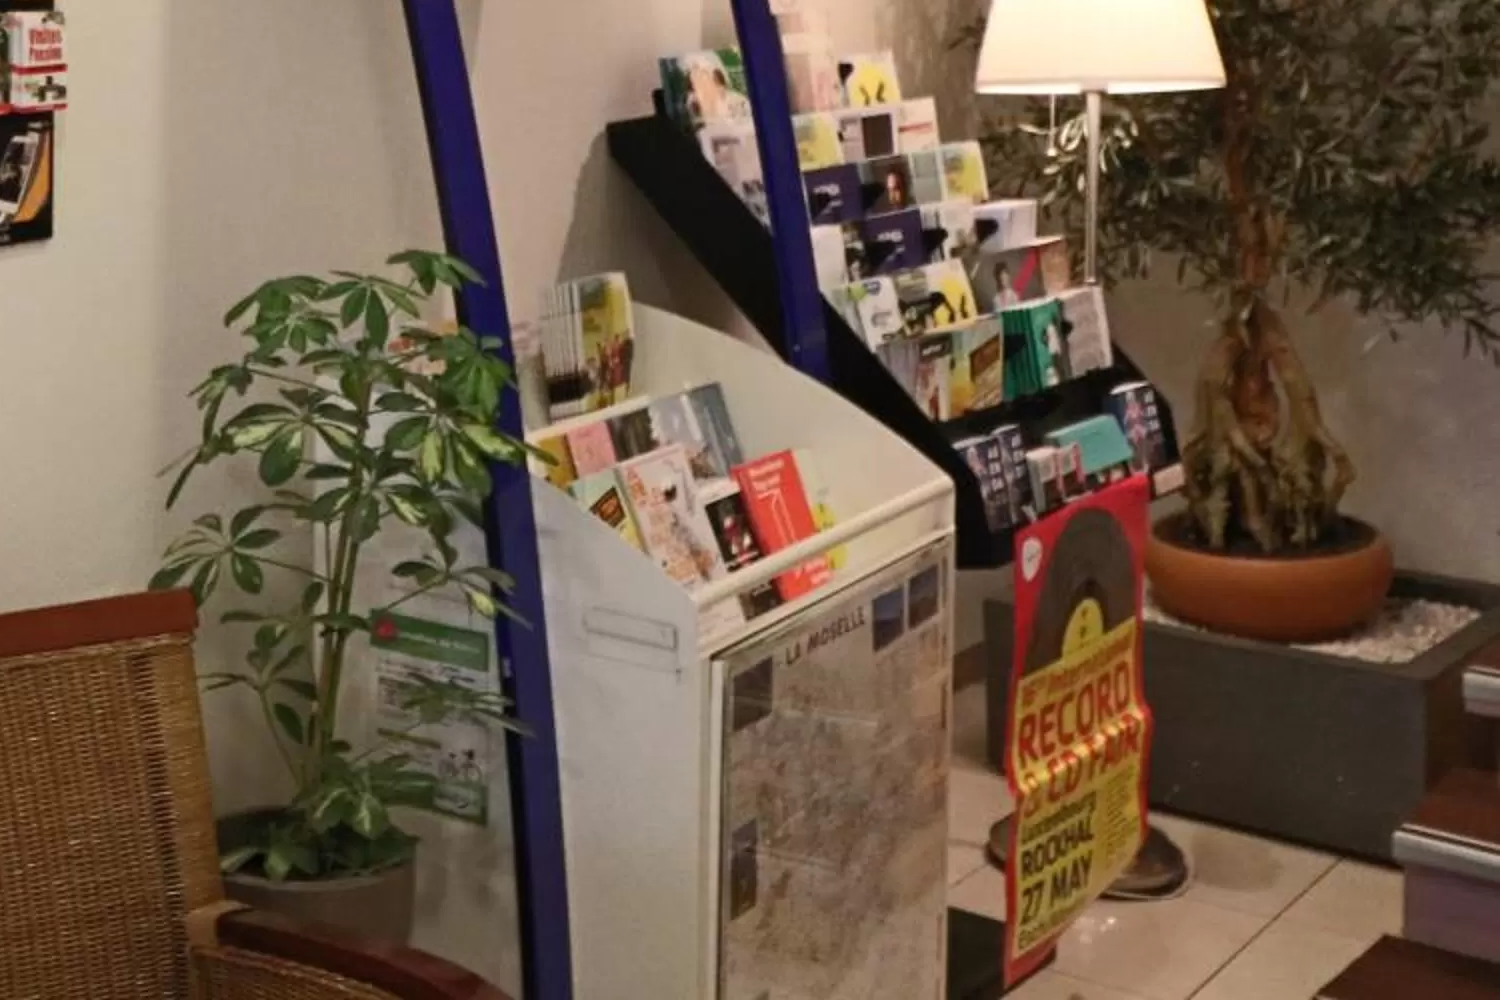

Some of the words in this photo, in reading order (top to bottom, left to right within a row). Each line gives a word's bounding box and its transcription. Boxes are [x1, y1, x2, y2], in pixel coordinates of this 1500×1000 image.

[1019, 660, 1130, 769] RECORD
[1021, 880, 1045, 925] 27
[1050, 849, 1093, 909] MAY
